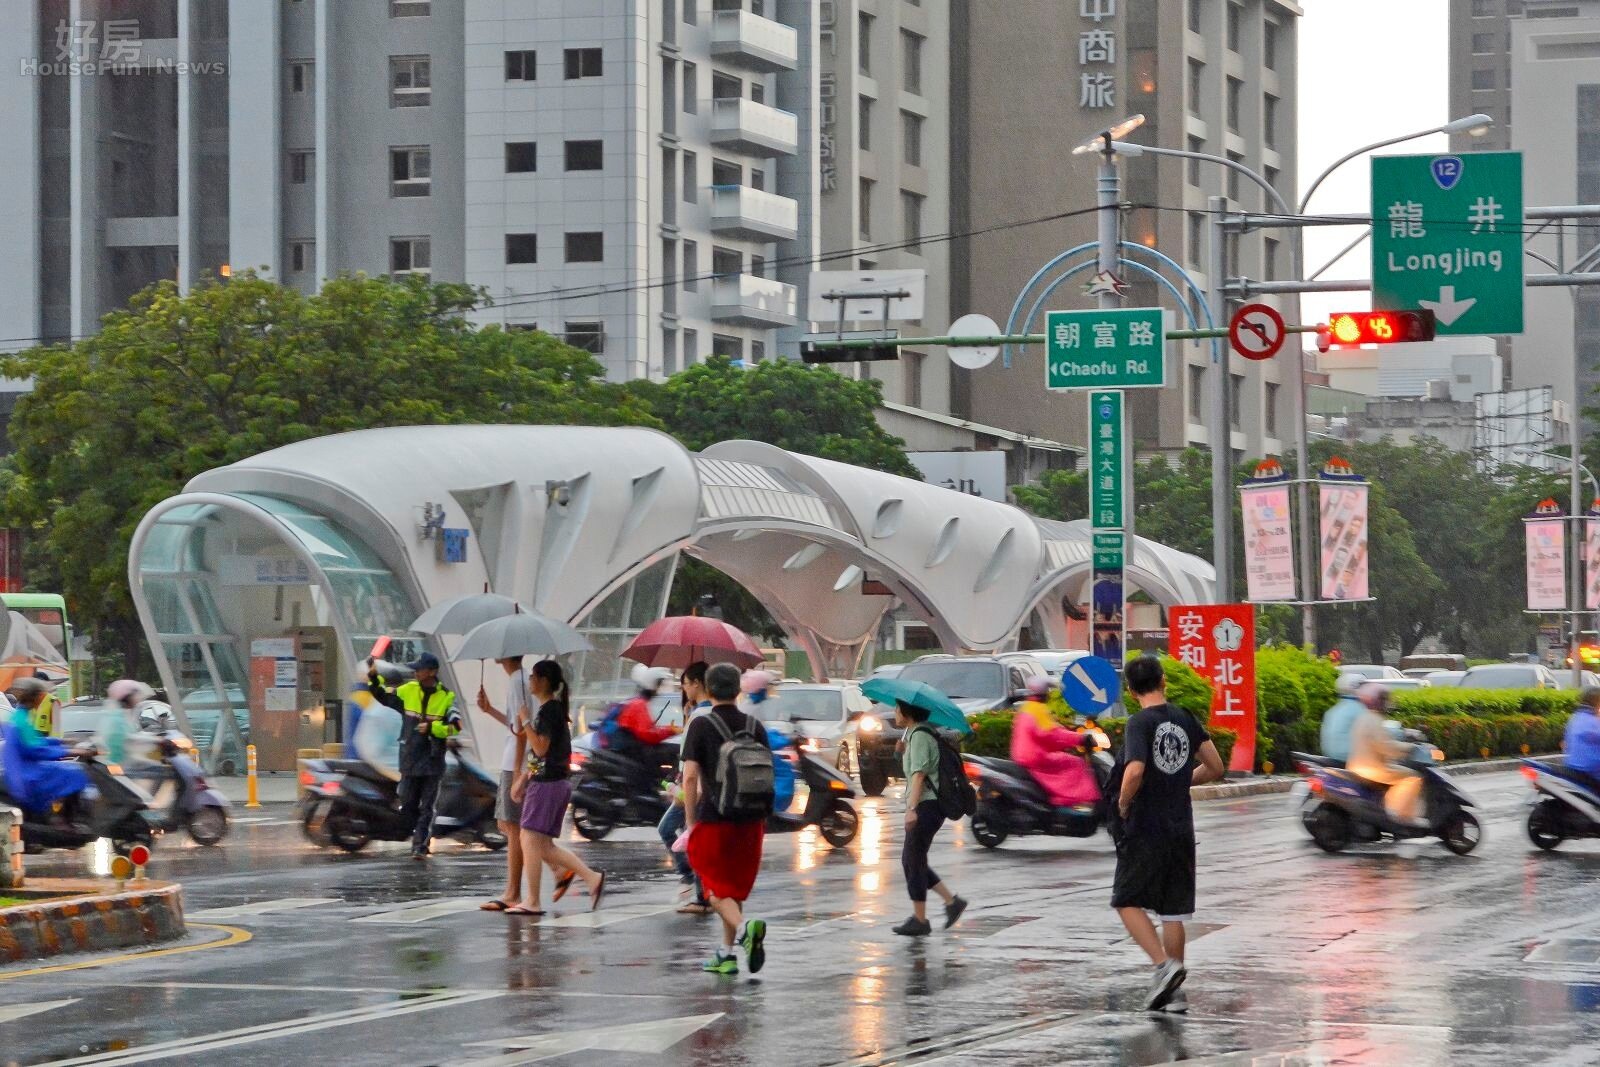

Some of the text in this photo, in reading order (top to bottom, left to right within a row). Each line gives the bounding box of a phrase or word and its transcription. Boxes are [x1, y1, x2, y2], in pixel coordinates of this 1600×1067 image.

[1438, 162, 1456, 176] 12
[1387, 196, 1504, 238] 龍井
[1388, 248, 1503, 275] Longjing
[1054, 321, 1155, 349] 朝富路
[1369, 317, 1393, 338] 45
[1060, 359, 1151, 376] Chaofu Rd.
[1178, 610, 1206, 669] 安和
[1214, 658, 1245, 715] 北上
